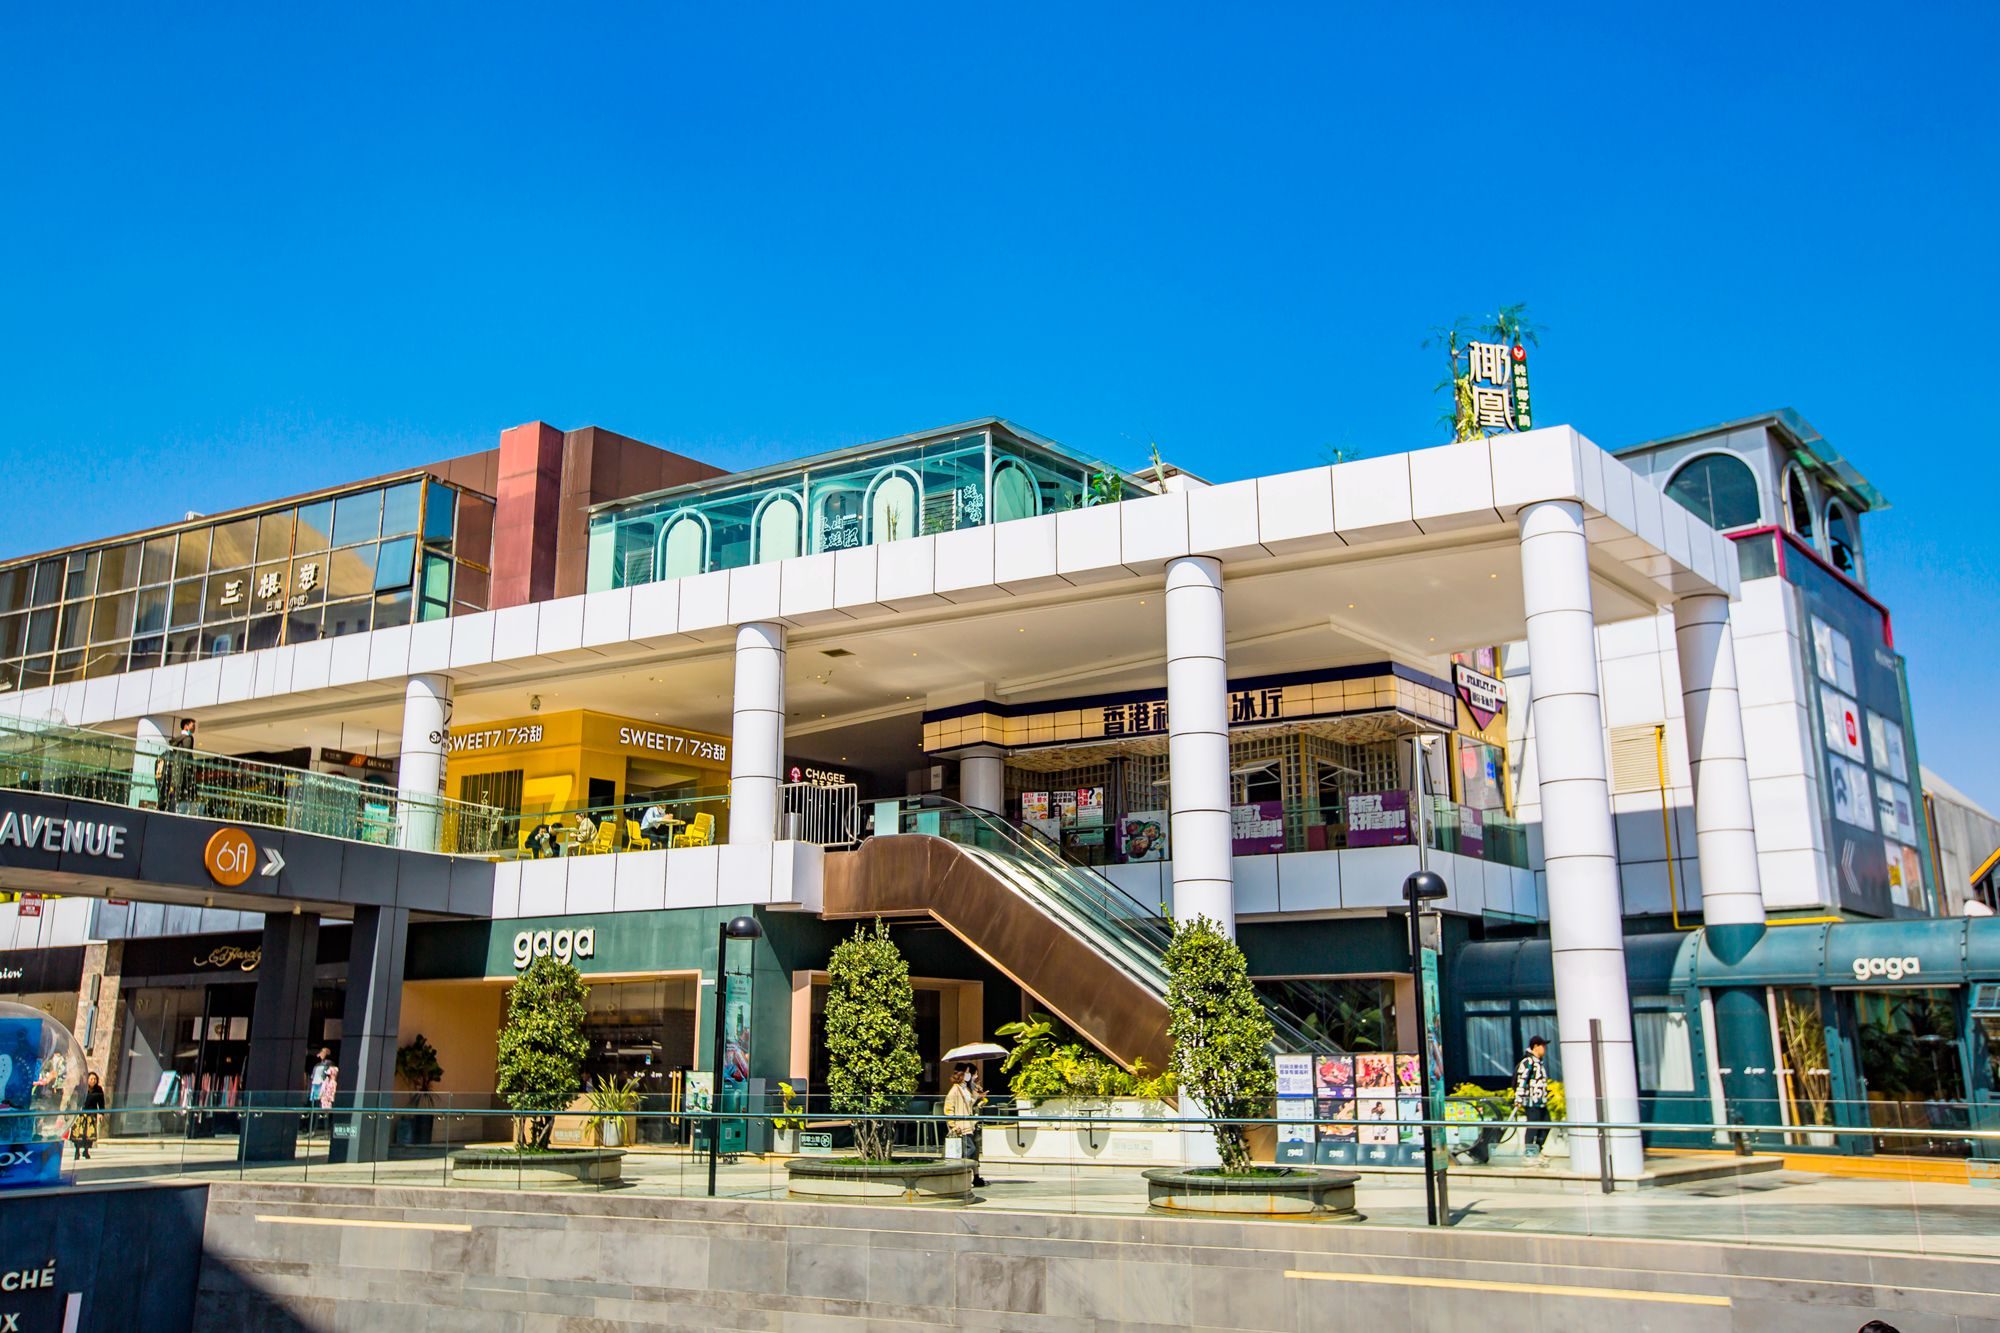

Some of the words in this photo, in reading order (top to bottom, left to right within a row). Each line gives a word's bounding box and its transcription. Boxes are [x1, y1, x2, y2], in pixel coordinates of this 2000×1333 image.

[1468, 341, 1515, 431] 椰凰
[220, 562, 320, 606] 三根葱
[508, 724, 544, 745] 7分甜
[620, 727, 684, 753] SWEET7
[689, 739, 727, 761] 7分甜
[805, 768, 846, 784] CHAGEE
[0, 811, 128, 860] AVENUE
[513, 927, 596, 970] gaga
[1852, 957, 1921, 981] gaga
[0, 1312, 21, 1333] X
